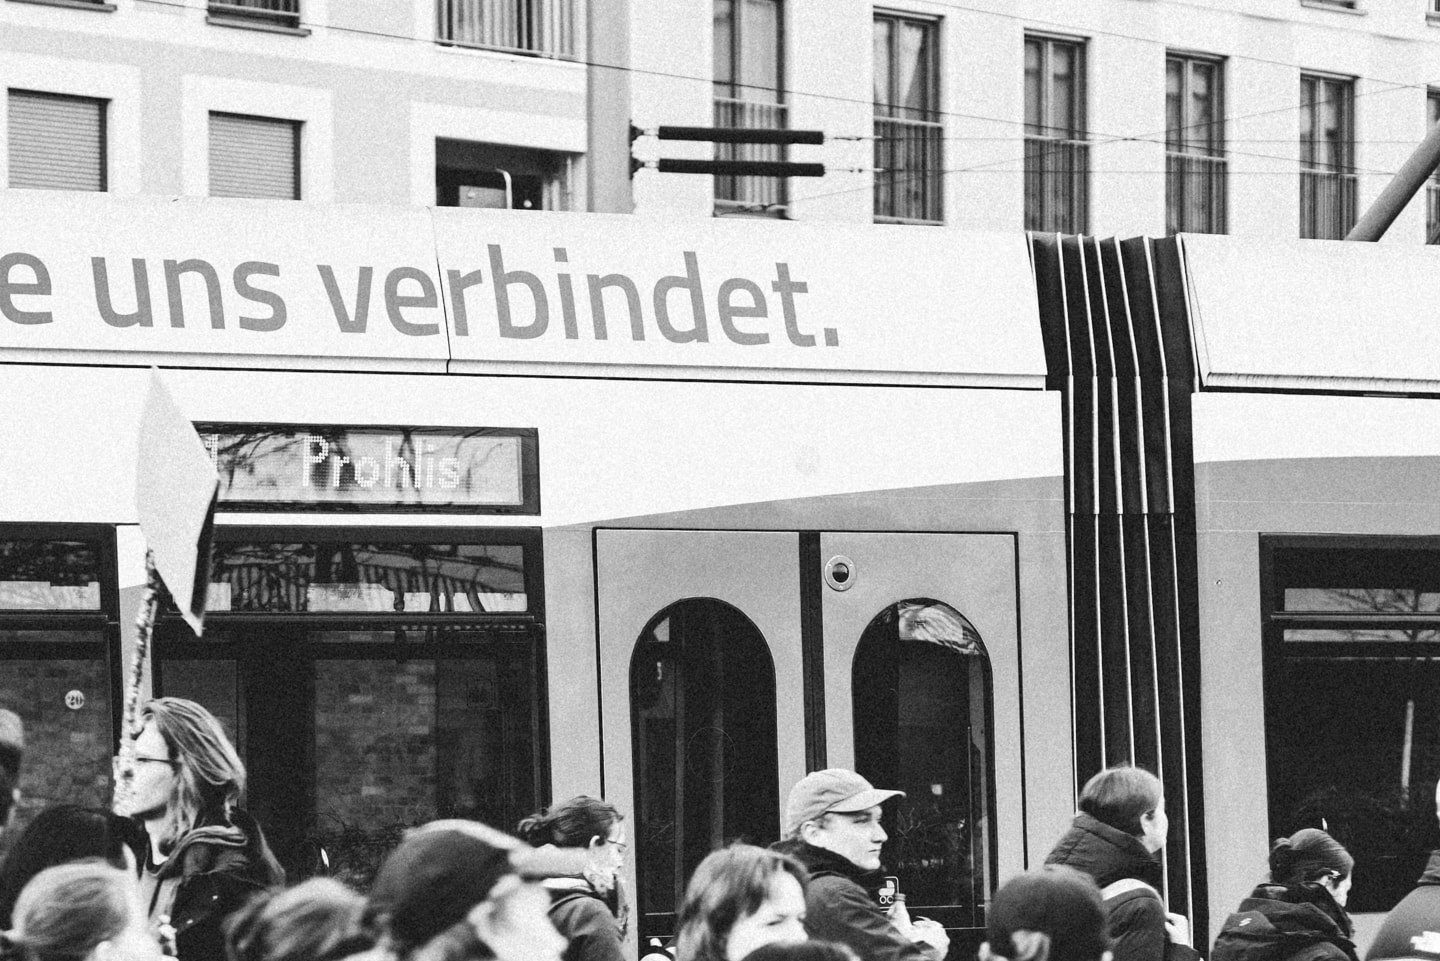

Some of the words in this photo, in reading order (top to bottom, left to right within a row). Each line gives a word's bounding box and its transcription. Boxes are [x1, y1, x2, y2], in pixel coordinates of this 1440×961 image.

[91, 256, 287, 332] uns
[317, 244, 839, 347] verbindet.
[302, 435, 460, 488] Prohlis
